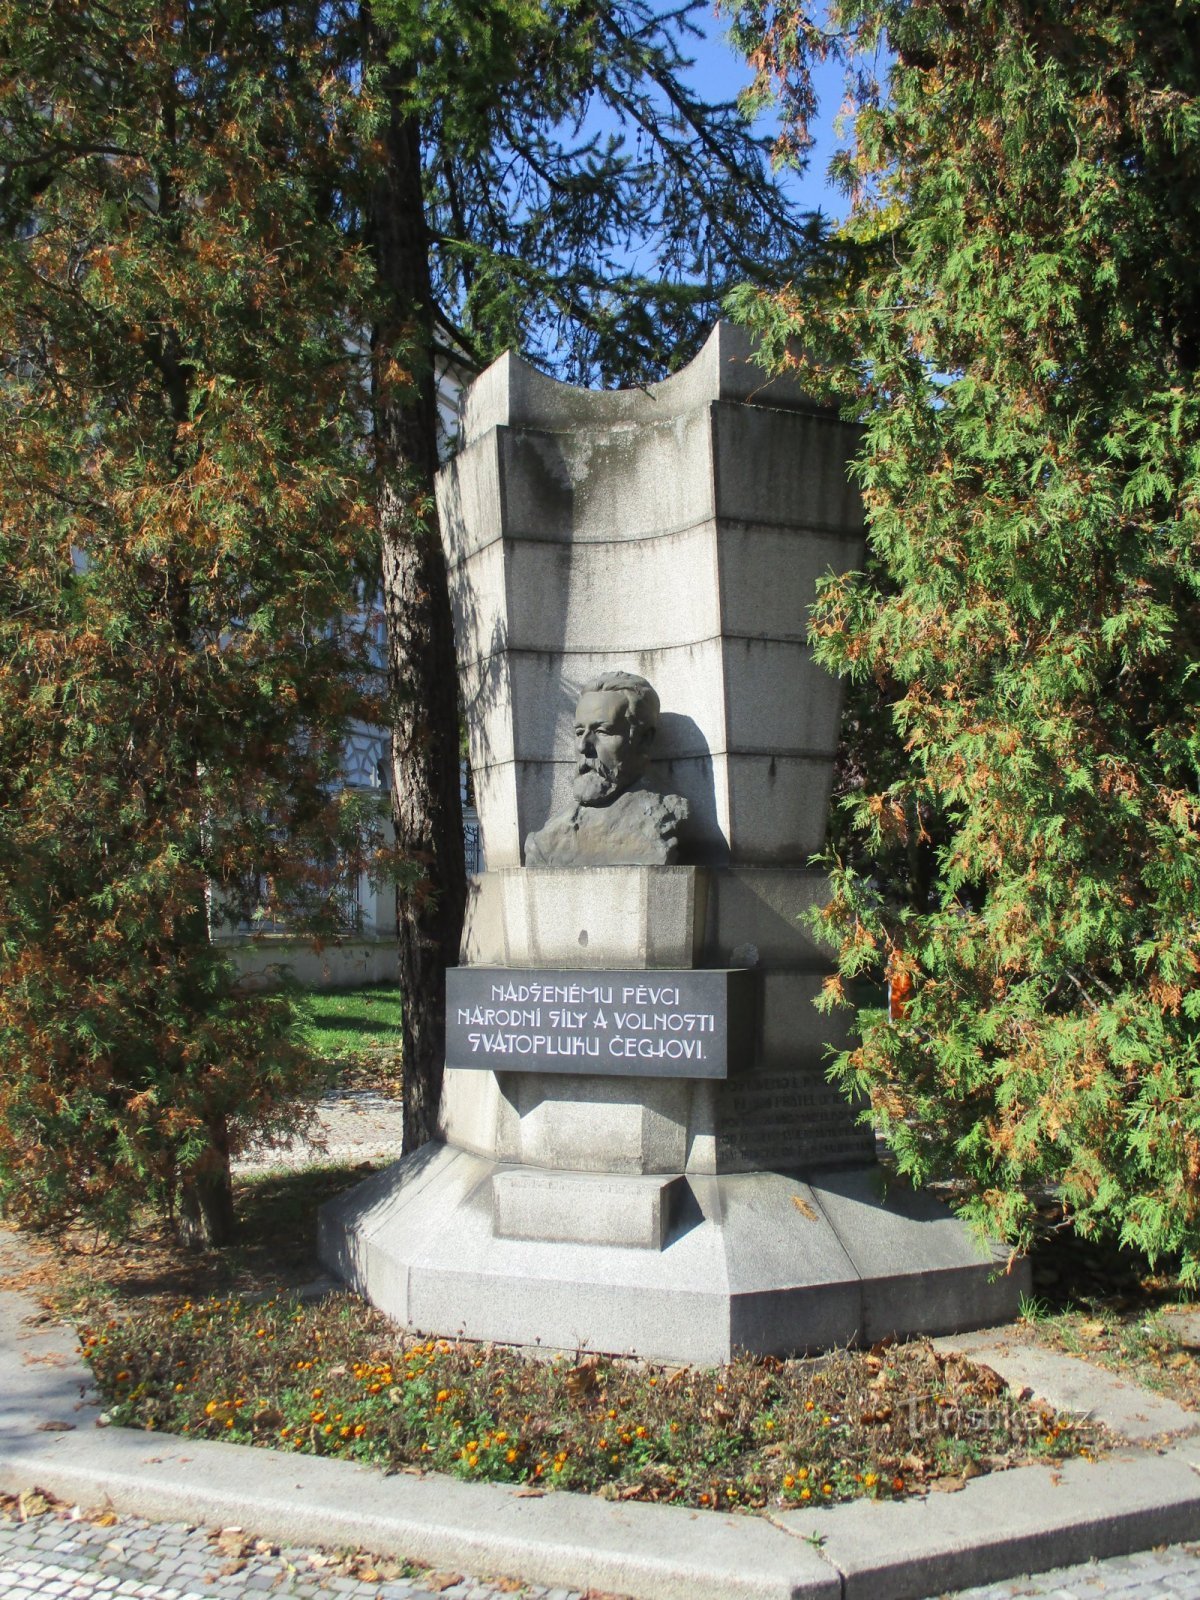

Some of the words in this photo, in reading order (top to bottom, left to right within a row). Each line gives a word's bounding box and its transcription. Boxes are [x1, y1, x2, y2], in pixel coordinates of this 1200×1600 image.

[491, 980, 613, 1004] NADŠENÉMU
[622, 984, 679, 1006] PĚVCI
[457, 1004, 541, 1027] NÁRODNÍ
[548, 1008, 588, 1029] SÍLY
[592, 1007, 608, 1029] A
[613, 1011, 714, 1032] VOLNOSTI
[467, 1028, 599, 1056] SVATOPLUKU
